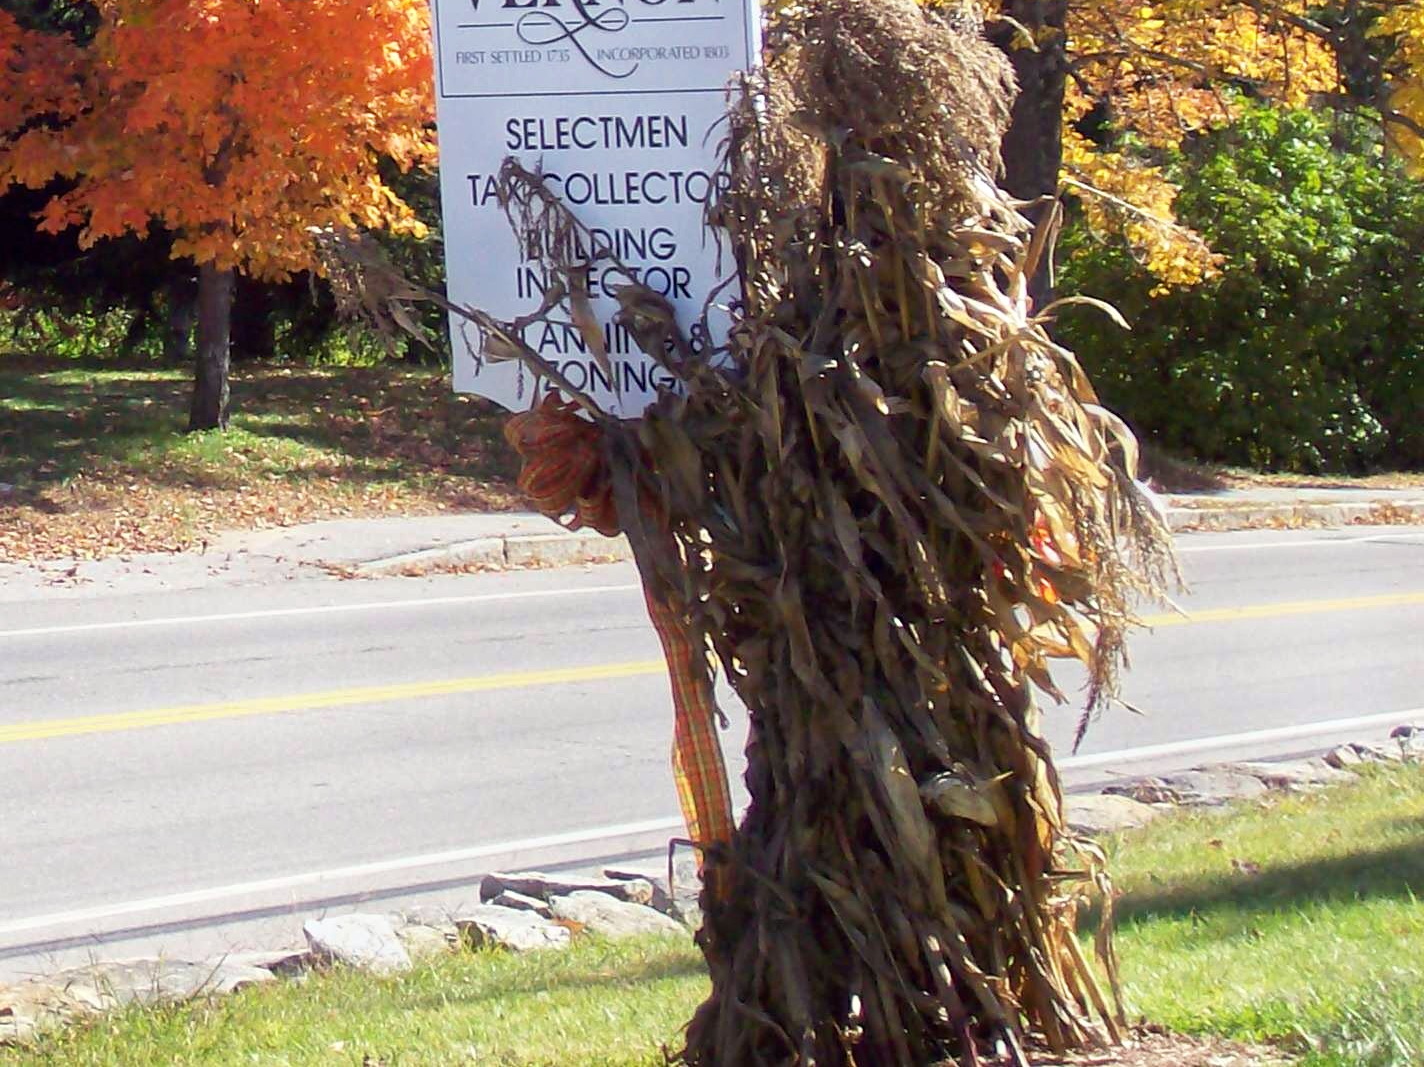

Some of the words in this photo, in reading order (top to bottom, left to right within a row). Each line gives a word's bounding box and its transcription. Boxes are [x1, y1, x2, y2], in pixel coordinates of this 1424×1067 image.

[456, 51, 485, 64] FIRST
[491, 49, 542, 64] SETTLED
[596, 46, 701, 61] INCORPORATED
[506, 115, 688, 150] SELECTMEN
[467, 175, 530, 205] TAX
[527, 227, 677, 261] BULDING
[517, 267, 693, 299] INECTOR
